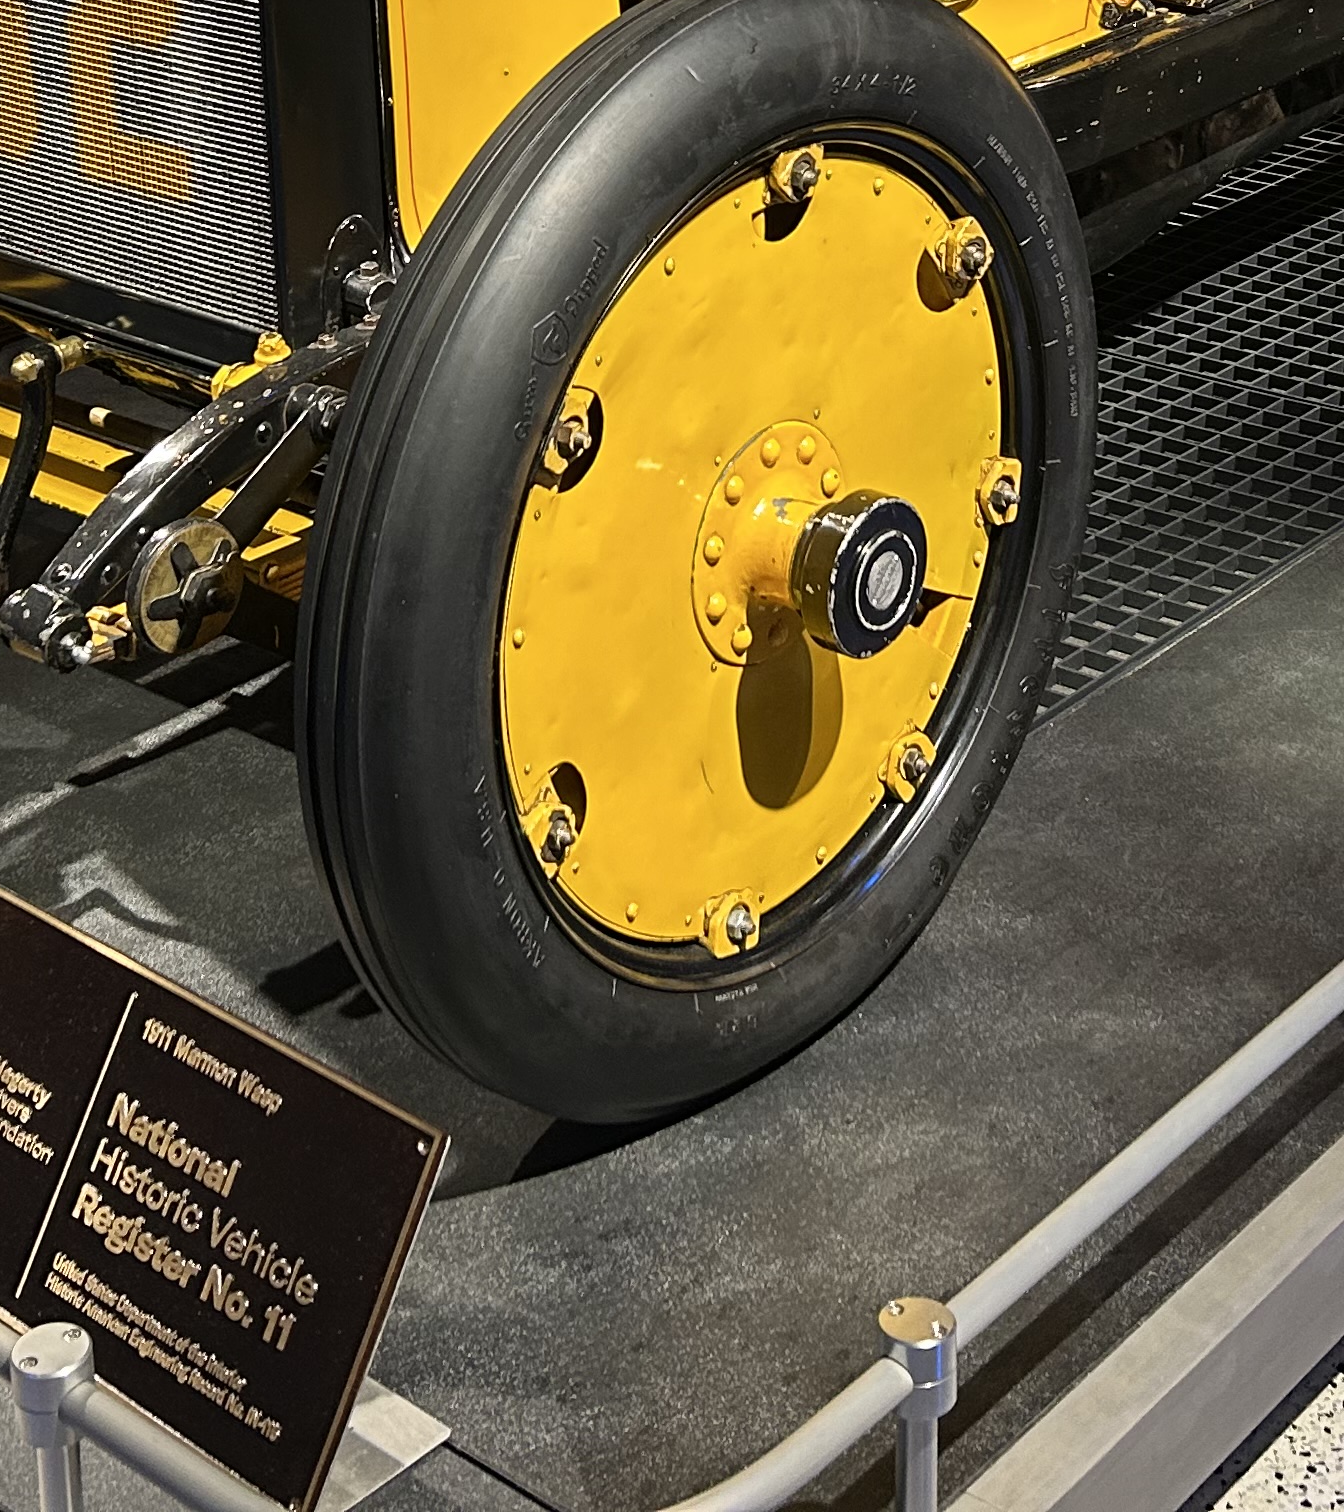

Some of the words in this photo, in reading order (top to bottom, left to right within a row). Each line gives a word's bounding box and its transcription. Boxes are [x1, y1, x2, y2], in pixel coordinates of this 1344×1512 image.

[142, 1017, 177, 1053] 1911
[172, 1034, 238, 1089] Marmon
[237, 1068, 283, 1117] Wasp
[106, 1091, 243, 1198] National
[71, 1181, 202, 1289] Register
[199, 1263, 254, 1329] No.
[261, 1304, 297, 1352] 11
[90, 1136, 203, 1234] Historic
[209, 1206, 319, 1306] Vehicle
[44, 1271, 86, 1309] Historic
[82, 1298, 132, 1341] American
[128, 1326, 191, 1385] Engineering
[52, 1251, 89, 1286] United
[84, 1273, 119, 1307] States
[116, 1294, 179, 1345] Department
